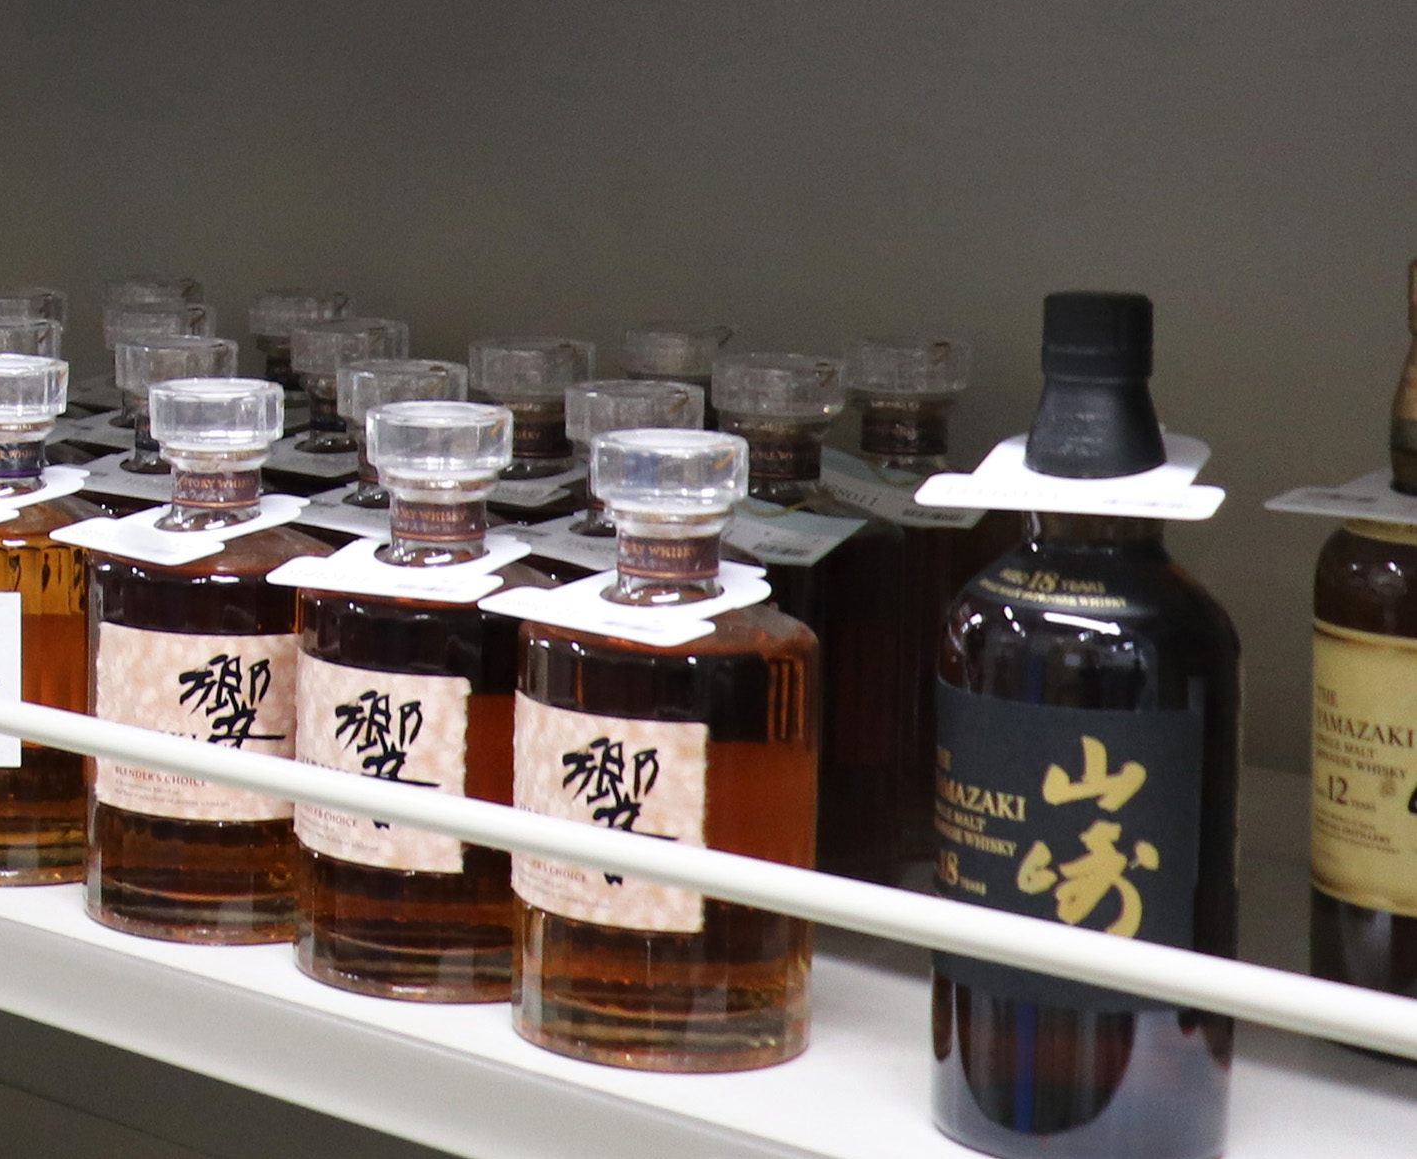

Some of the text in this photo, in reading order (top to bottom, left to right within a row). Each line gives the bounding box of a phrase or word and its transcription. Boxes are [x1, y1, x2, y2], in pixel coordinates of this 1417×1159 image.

[1029, 570, 1060, 594] 18
[178, 653, 286, 749] 響
[1315, 707, 1414, 751] YAMAZAKI
[114, 764, 163, 783] BLENDER'S
[334, 688, 442, 831] 響
[1355, 759, 1409, 780] WHISKY
[936, 772, 1027, 823] MAZAKI
[1327, 774, 1349, 807] 12
[323, 810, 359, 829] CHOICE
[560, 735, 681, 887] 響
[963, 830, 1018, 859] WHISKY
[1018, 735, 1160, 941] 山崎
[940, 850, 959, 887] 18
